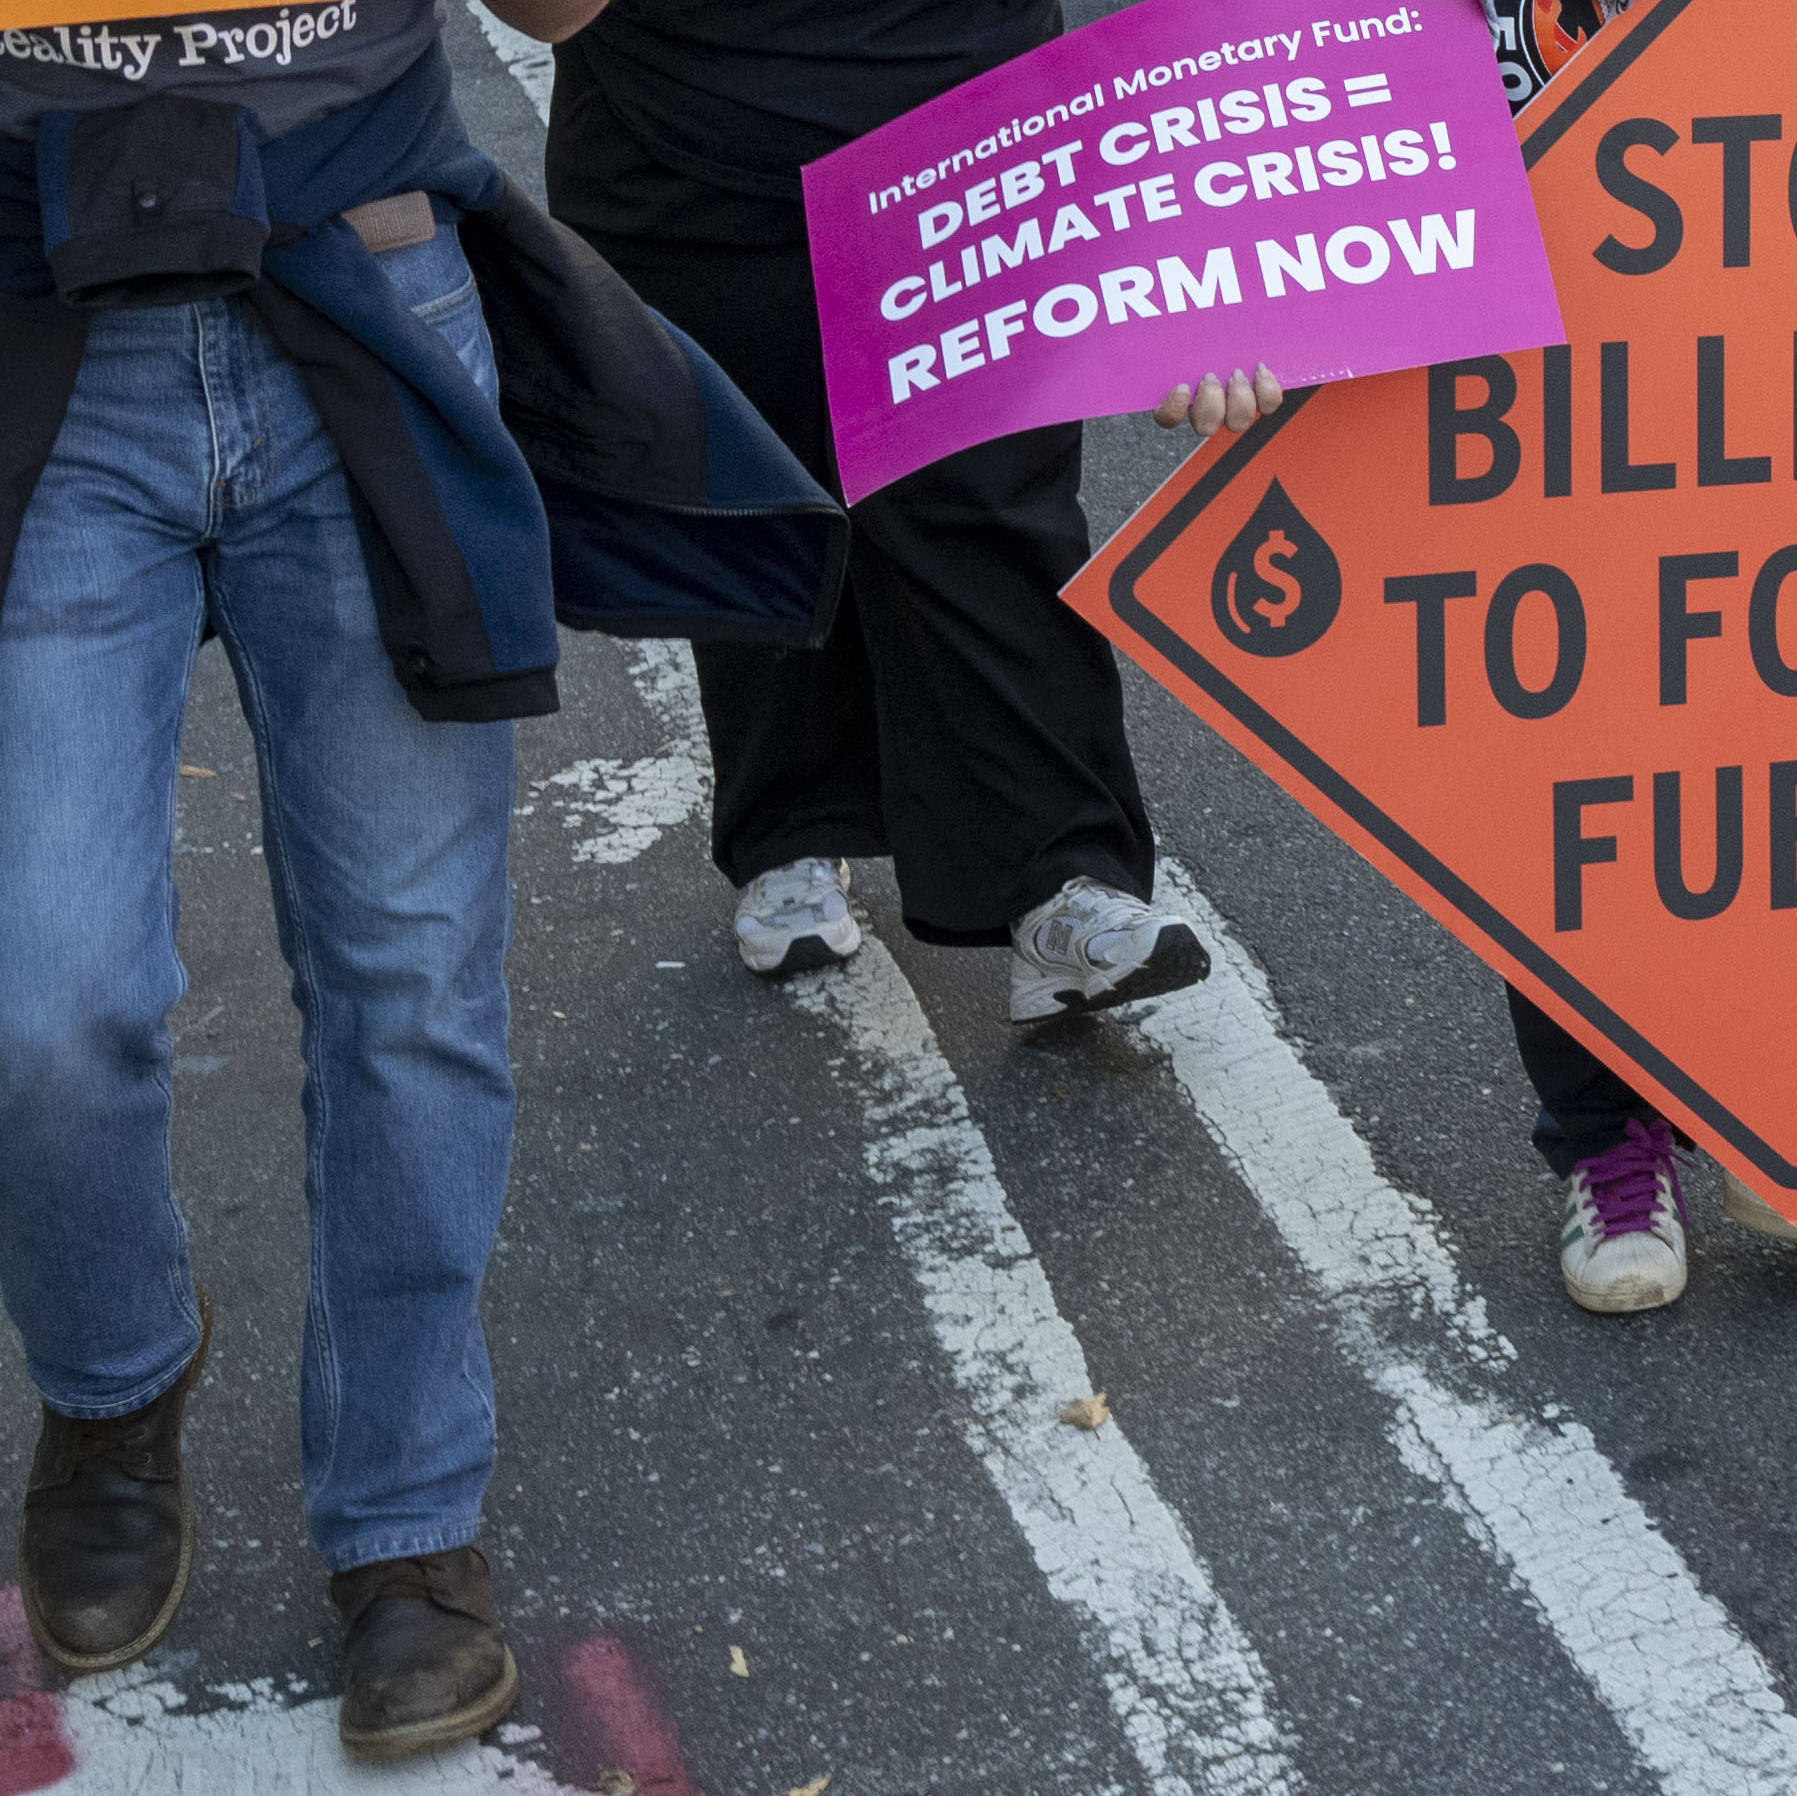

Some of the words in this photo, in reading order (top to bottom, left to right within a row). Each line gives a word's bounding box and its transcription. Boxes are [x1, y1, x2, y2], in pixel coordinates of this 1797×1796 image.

[0, 25, 162, 81] eality
[869, 83, 1106, 216] International
[1113, 28, 1303, 101] Monetary
[1312, 6, 1423, 50] Fund:
[879, 172, 1183, 323] CLIMATE
[1192, 121, 1459, 207] CRISIS!
[918, 140, 1084, 251] DEBT
[1098, 75, 1332, 169] CRISIS
[1343, 71, 1393, 107] =
[887, 246, 1243, 405] REFORM
[1254, 207, 1477, 300] NOW
[1382, 560, 1589, 728] TO
